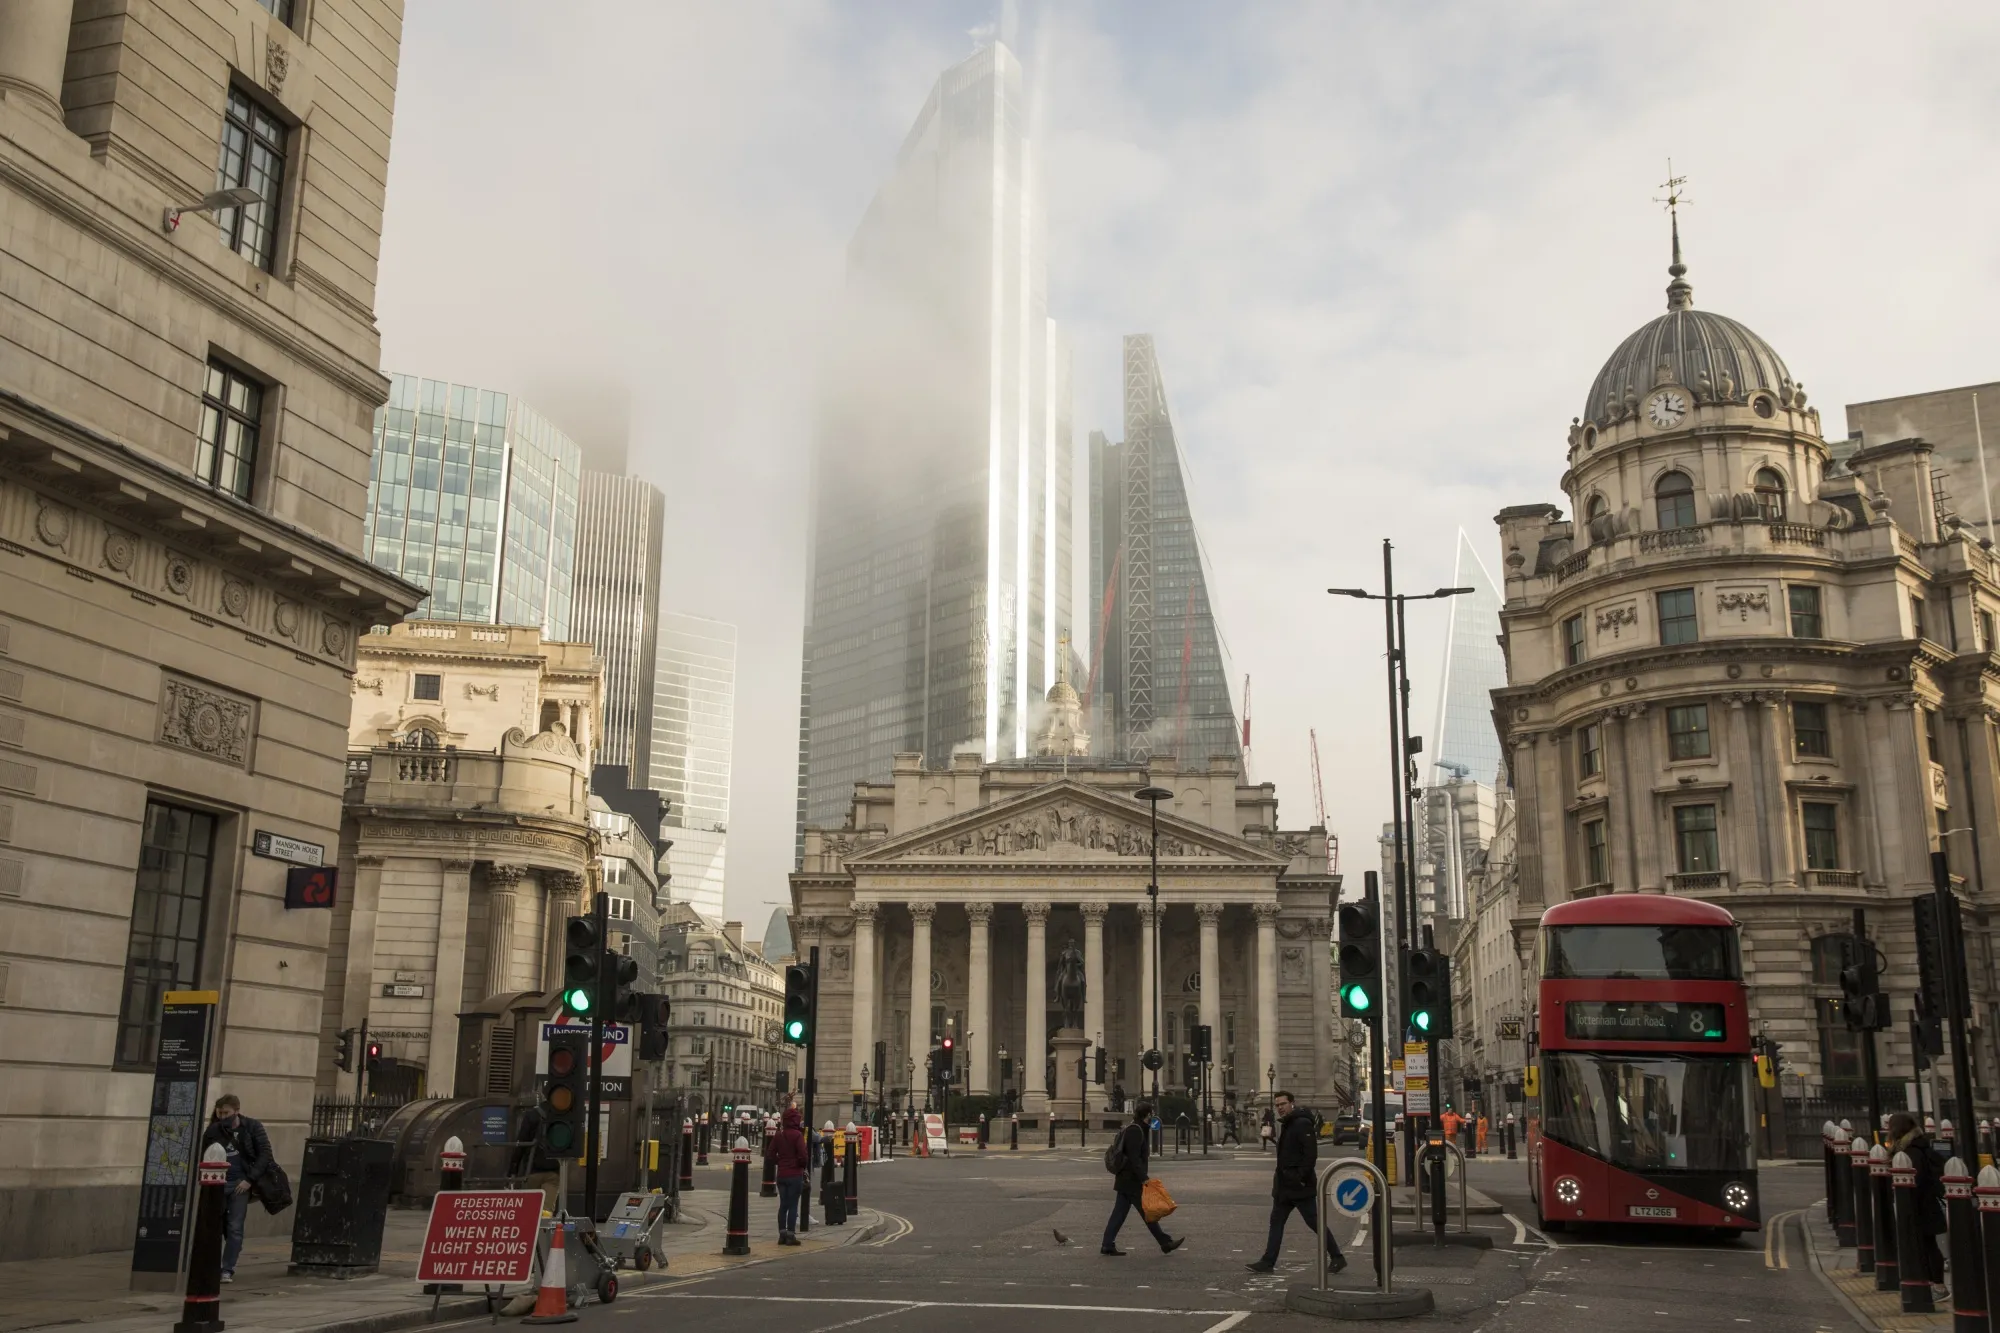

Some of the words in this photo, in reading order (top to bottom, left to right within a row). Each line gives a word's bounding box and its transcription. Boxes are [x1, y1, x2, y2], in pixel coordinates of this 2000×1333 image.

[275, 847, 294, 858] STREET
[276, 839, 300, 851] MANSION
[302, 845, 319, 856] HOUSE
[1576, 1013, 1616, 1026] Tottenham
[1619, 1014, 1641, 1026] Court
[1689, 1010, 1705, 1033] 8
[370, 1030, 429, 1039] UNDERGROUND
[454, 1198, 524, 1208] PEDESTRIAN
[456, 1210, 516, 1220] CROSSING
[1634, 1208, 1652, 1216] LTZ
[445, 1226, 487, 1239] WHEN
[492, 1226, 520, 1238] RED
[430, 1242, 472, 1254] LIGHT
[475, 1242, 528, 1254] SHOWS
[433, 1262, 468, 1275] WAIT
[472, 1260, 518, 1276] HERE
